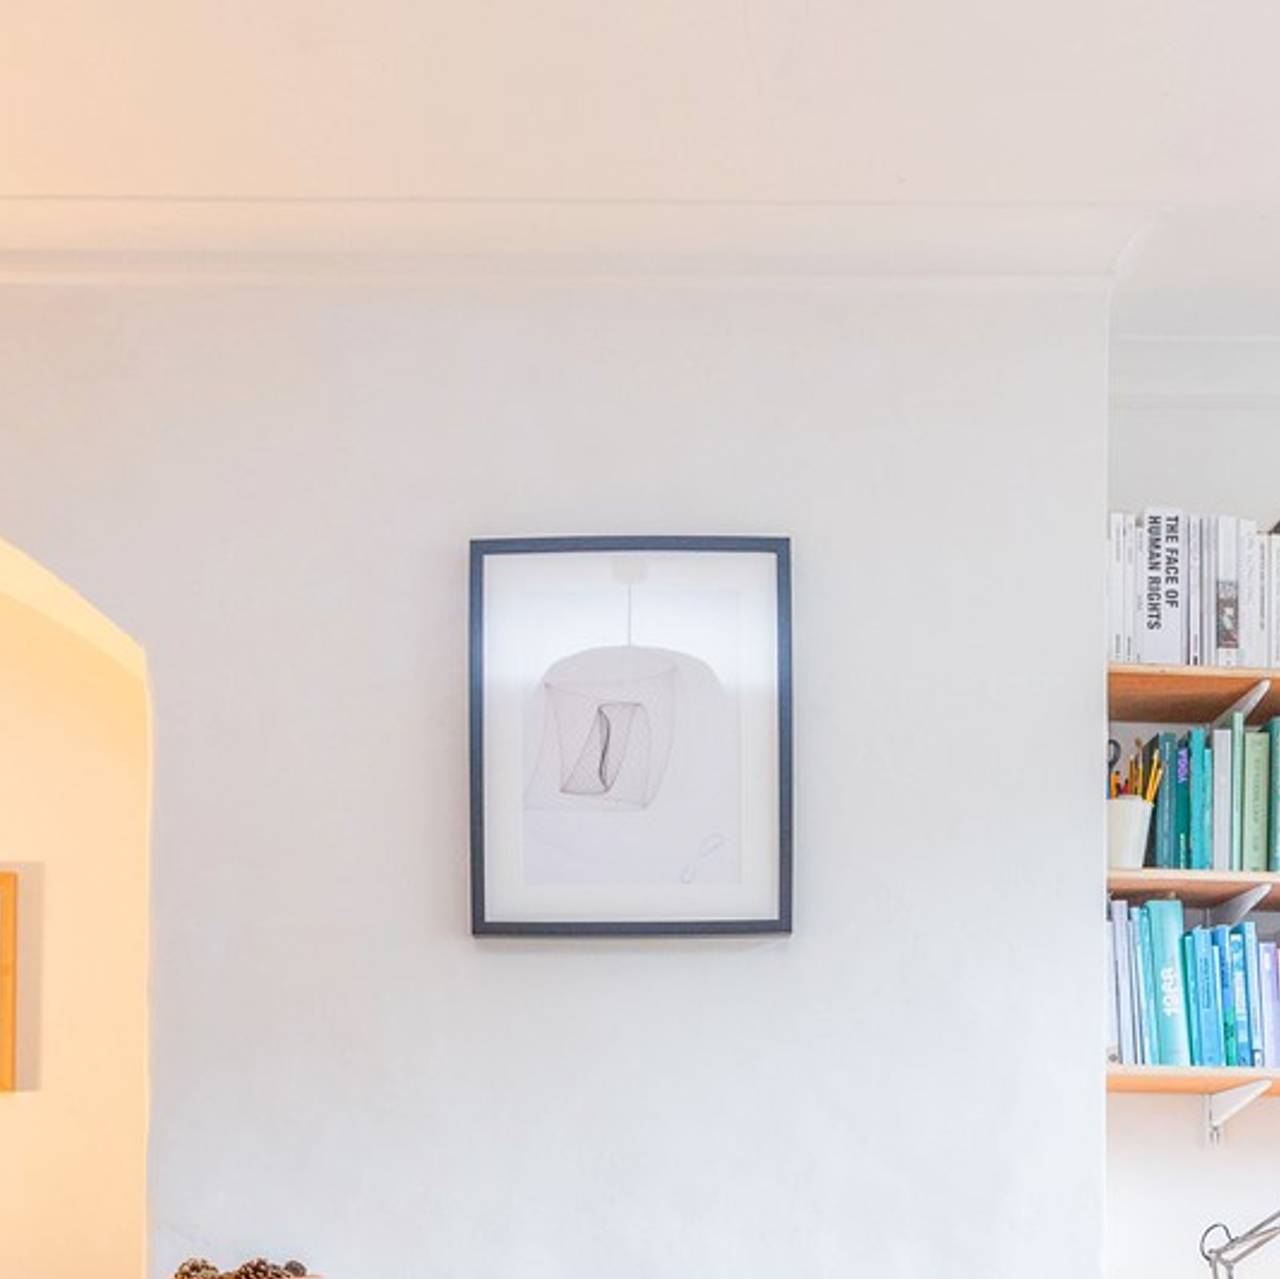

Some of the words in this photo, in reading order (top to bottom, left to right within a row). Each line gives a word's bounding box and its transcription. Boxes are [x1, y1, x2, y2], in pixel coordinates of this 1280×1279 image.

[1148, 515, 1161, 570] HUMAN
[1166, 515, 1179, 543] THE
[1166, 548, 1179, 583] FACE
[1146, 576, 1161, 630] RIGHTS
[1166, 589, 1179, 608] OF
[1177, 748, 1189, 784] YOGA
